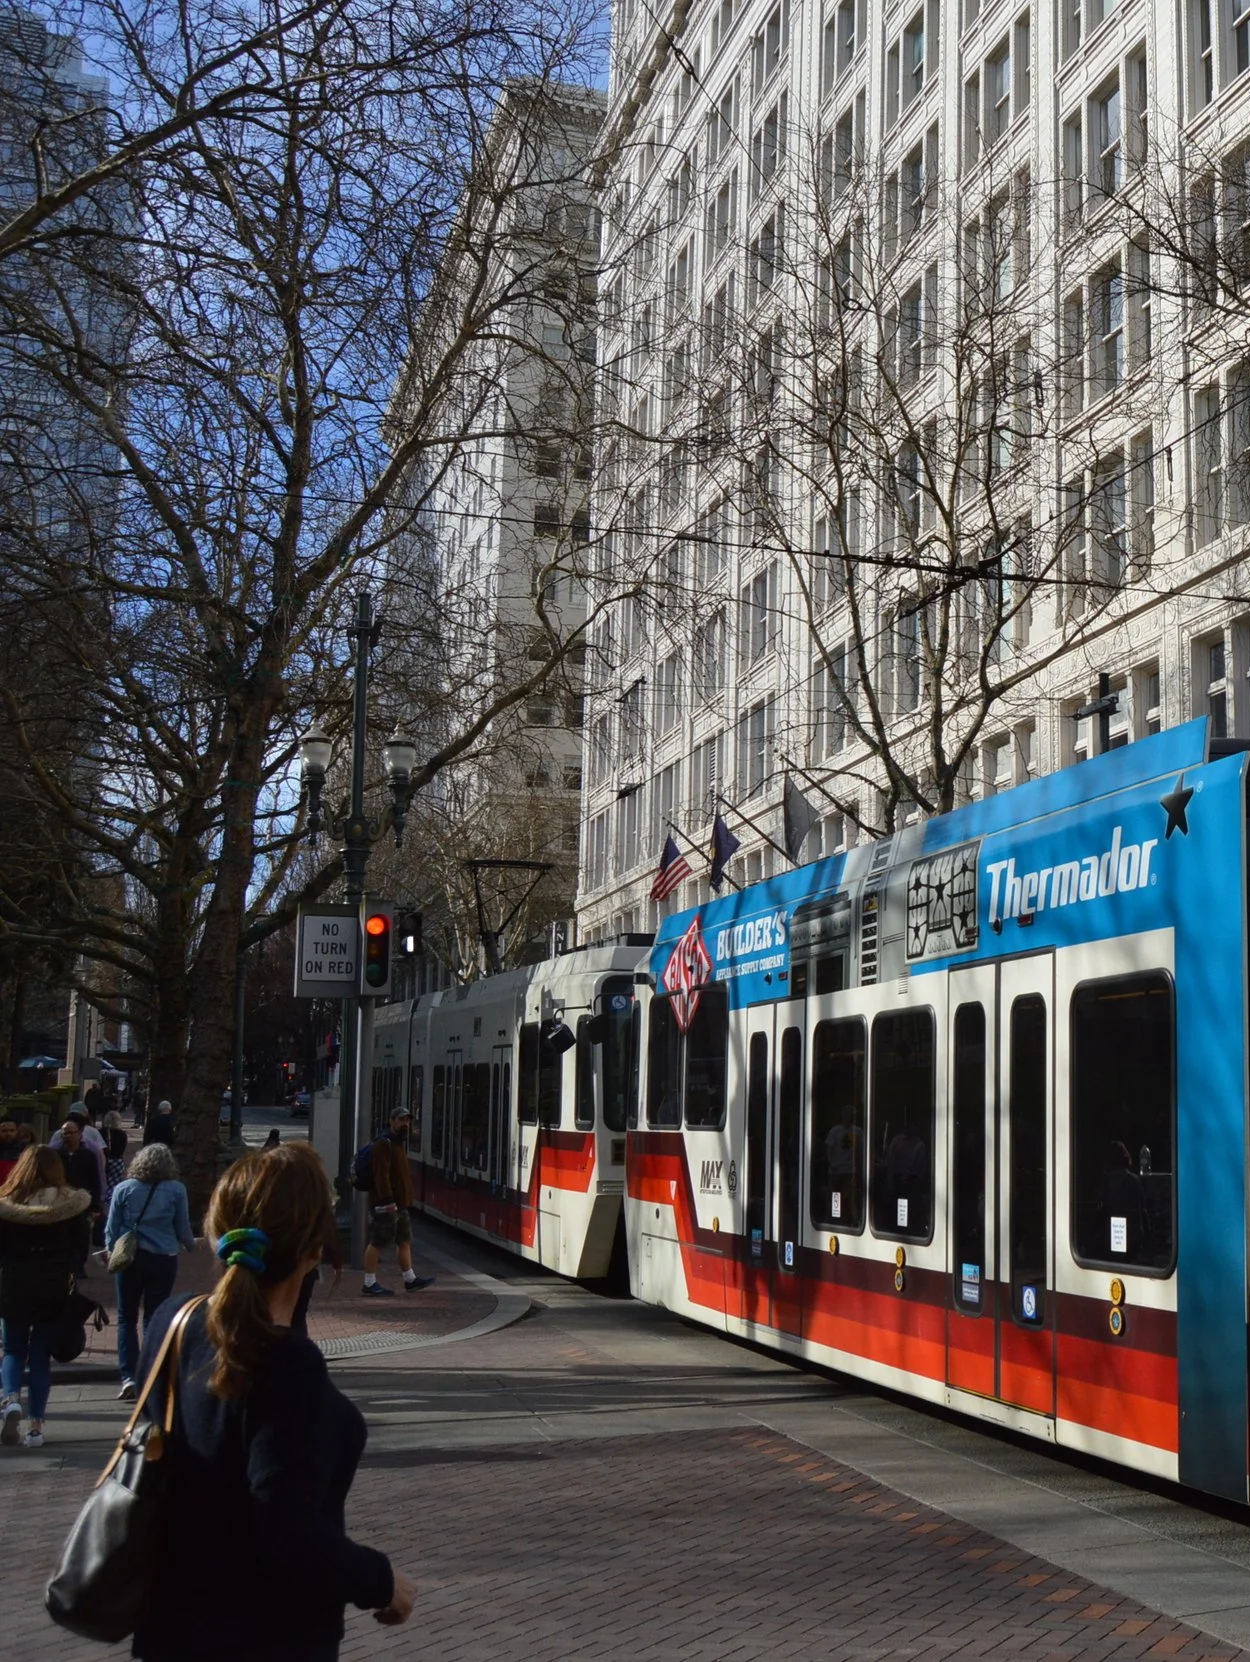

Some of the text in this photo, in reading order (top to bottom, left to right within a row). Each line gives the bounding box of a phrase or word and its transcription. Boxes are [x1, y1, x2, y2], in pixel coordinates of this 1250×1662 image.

[986, 825, 1158, 923] Thermador
[321, 923, 340, 936] NO
[716, 910, 788, 961] BUILDER'S
[313, 942, 348, 956] TURN
[305, 961, 354, 974] ON RED
[741, 960, 760, 976] SUPPLY
[759, 953, 785, 971] COMPANY
